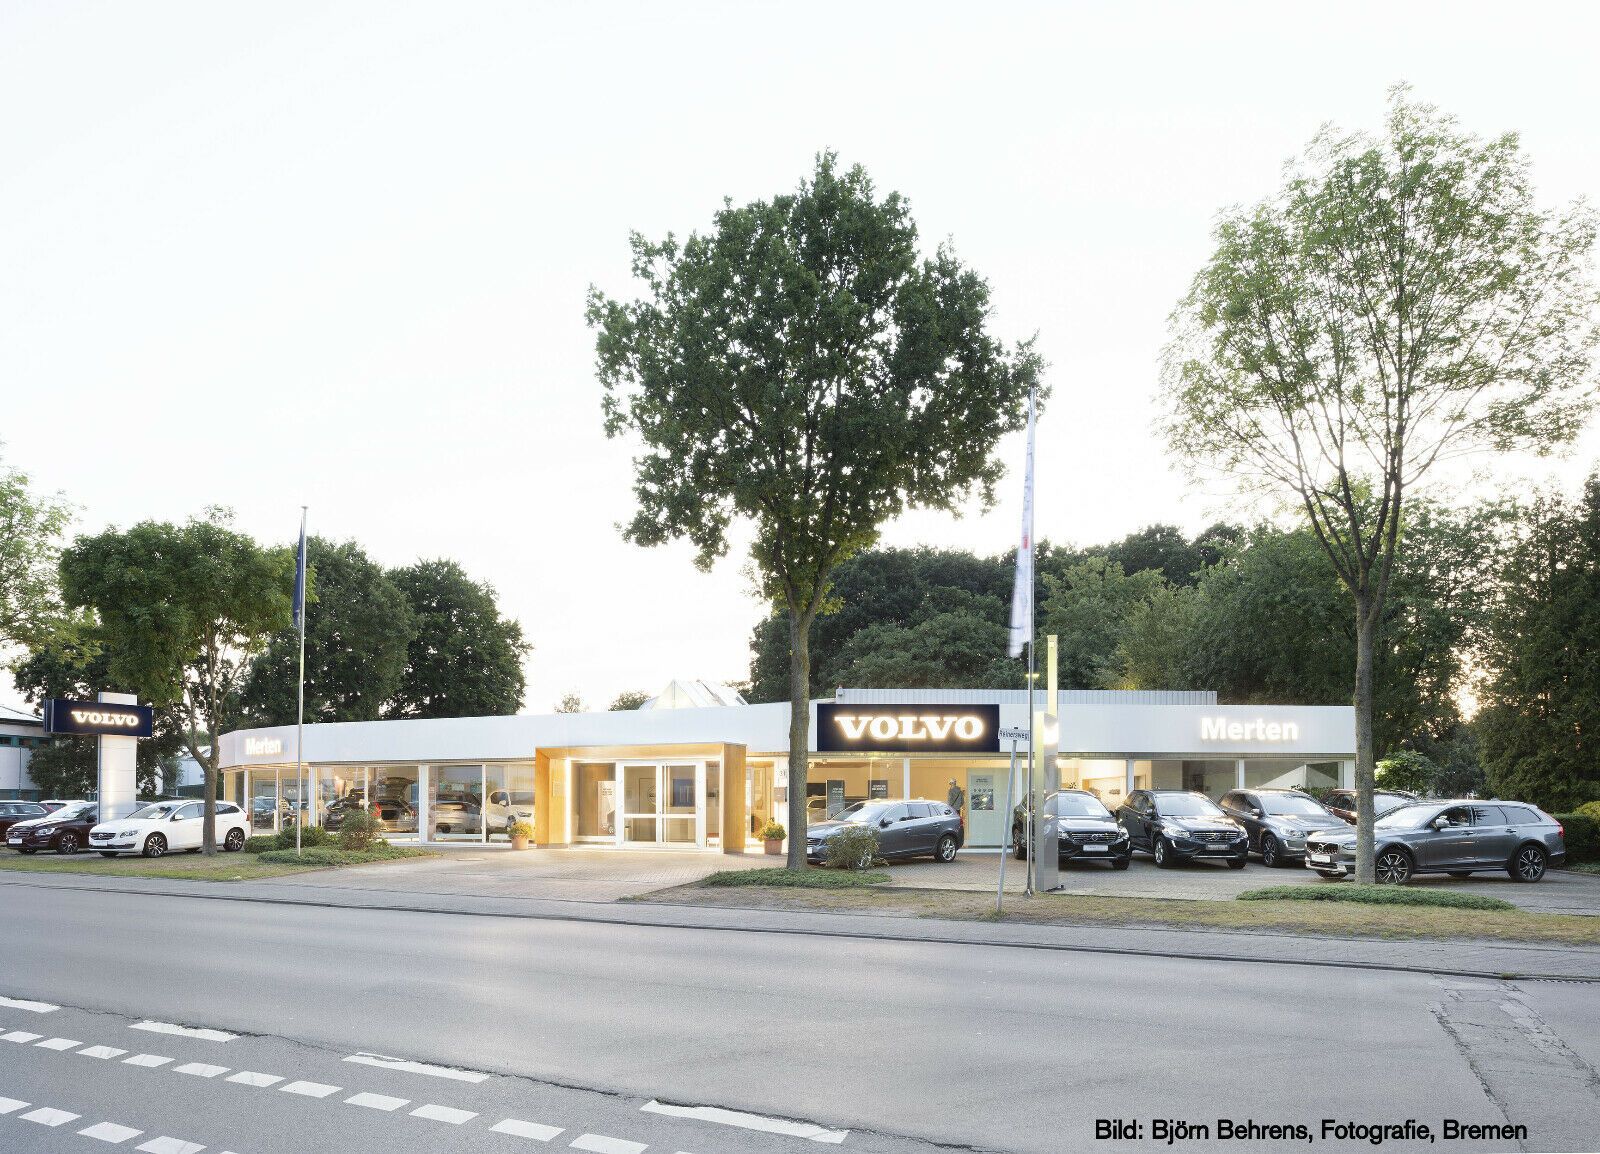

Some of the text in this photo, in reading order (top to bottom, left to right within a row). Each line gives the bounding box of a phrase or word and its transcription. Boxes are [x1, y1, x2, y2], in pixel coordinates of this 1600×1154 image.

[71, 711, 139, 726] VOLVO
[834, 716, 984, 740] VOLVO
[1201, 717, 1299, 740] Merten
[245, 737, 281, 755] Merten
